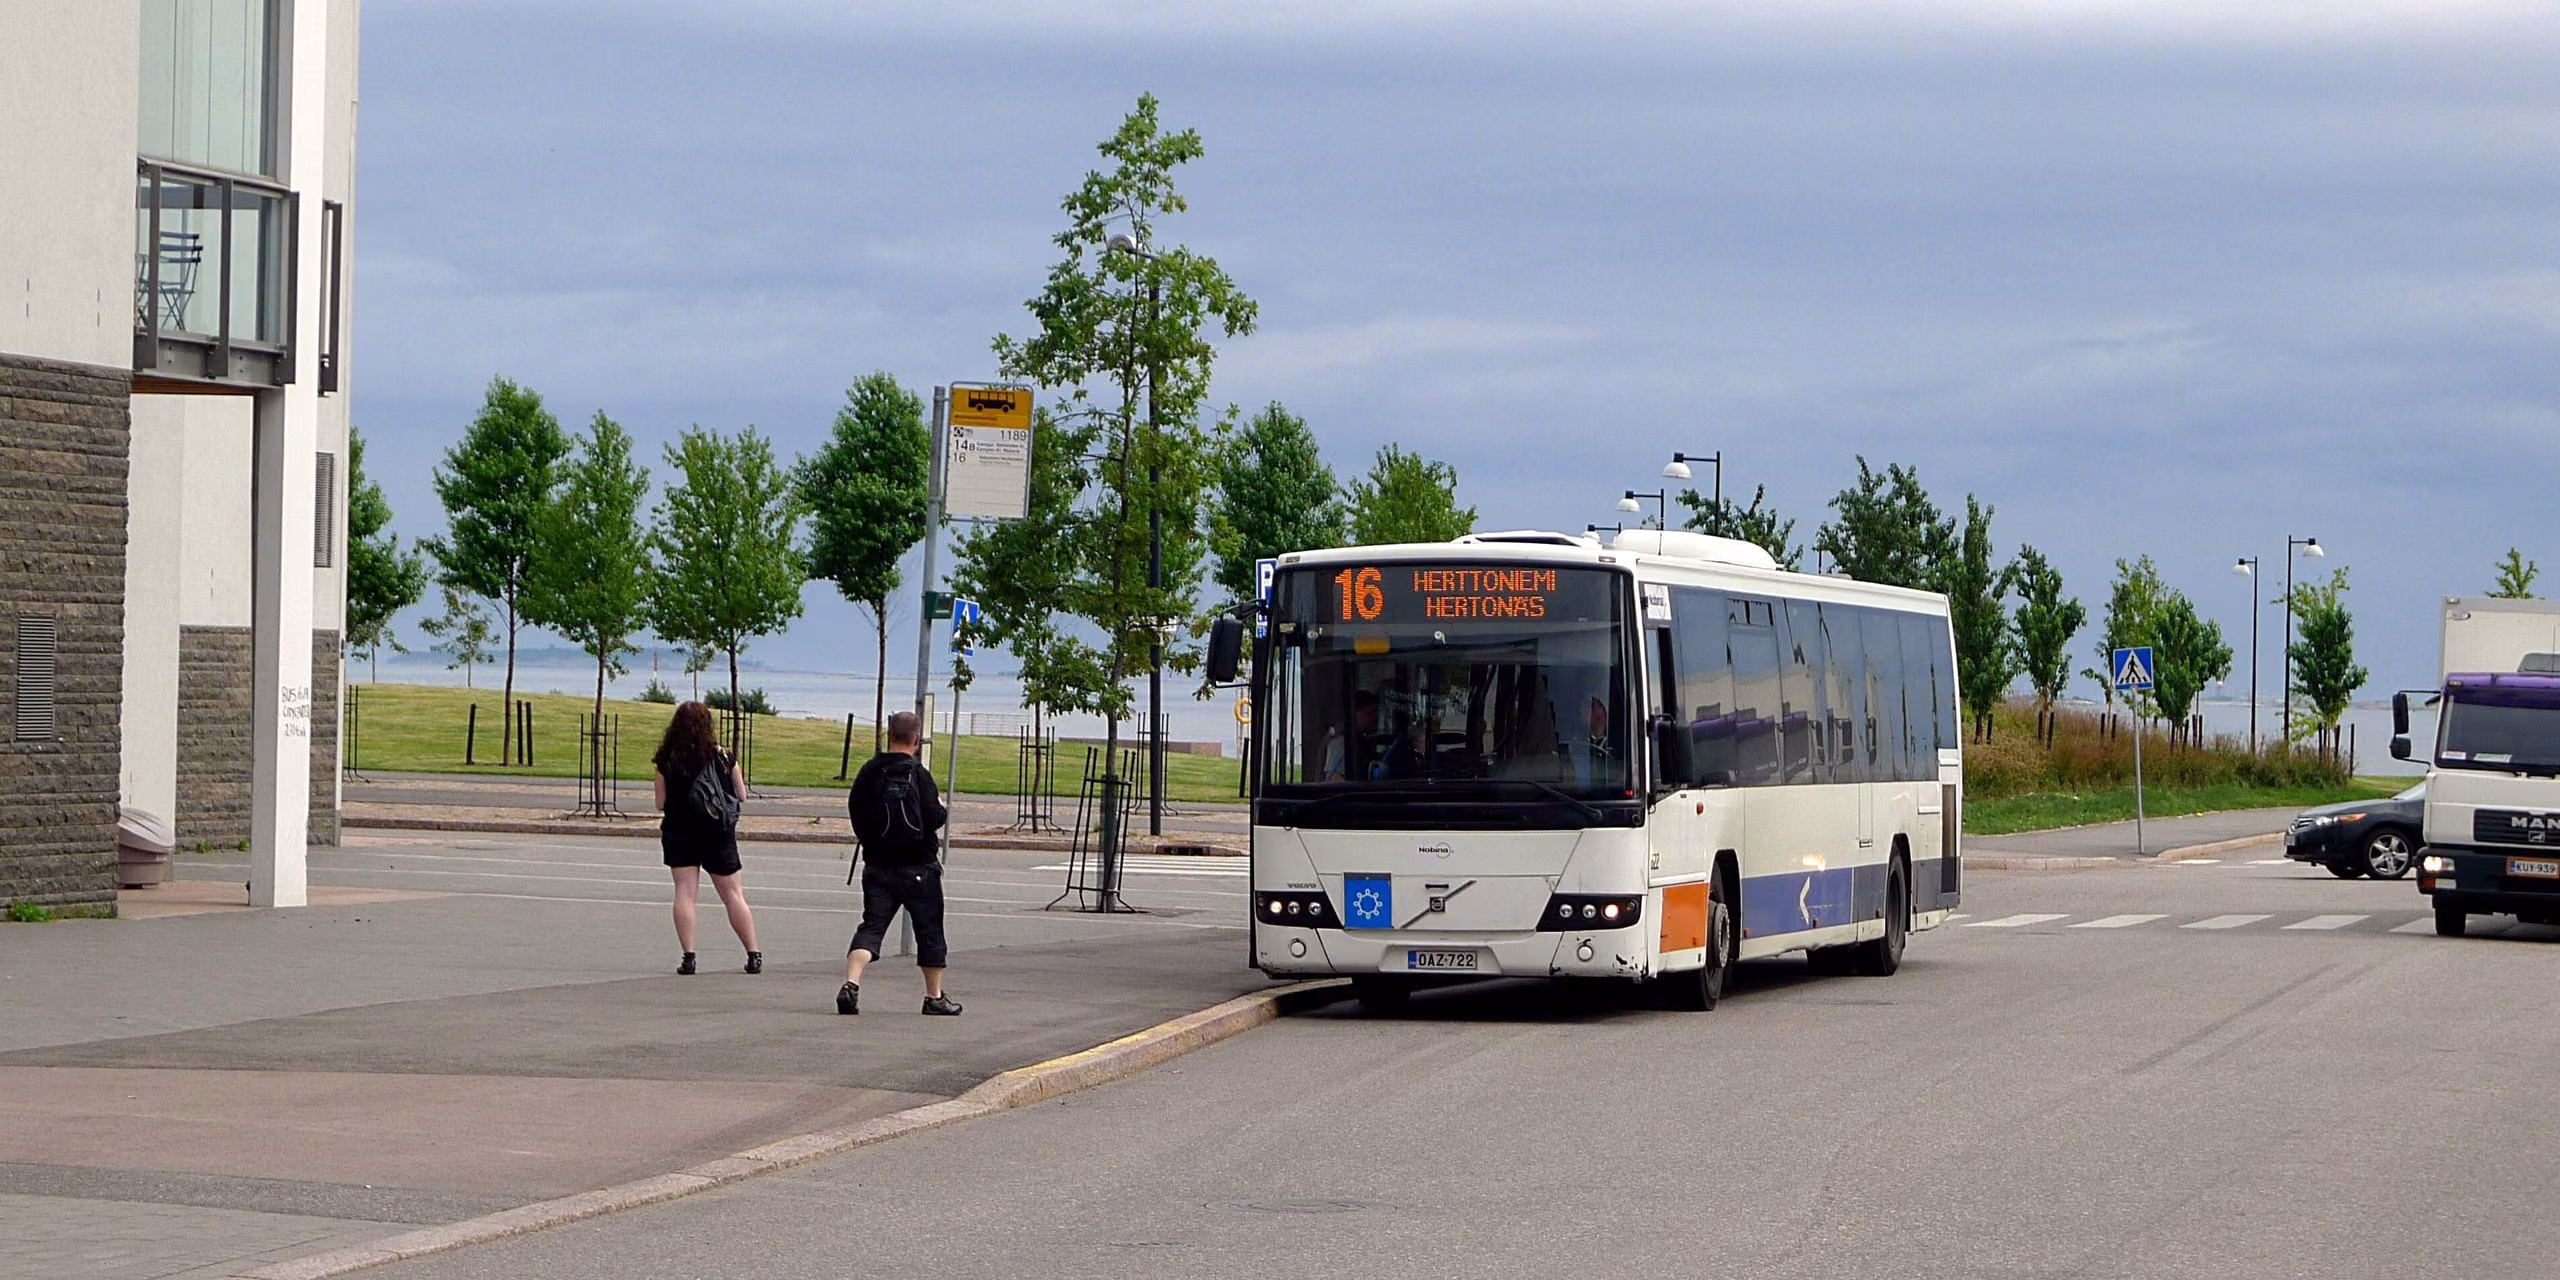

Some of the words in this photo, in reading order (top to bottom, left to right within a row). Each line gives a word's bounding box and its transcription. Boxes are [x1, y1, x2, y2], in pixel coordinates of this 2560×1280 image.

[1000, 429, 1027, 441] 1189
[953, 452, 966, 463] 16
[1260, 563, 1274, 600] P
[1334, 567, 1385, 621] 16
[1413, 569, 1557, 593] HERTTONIEMI
[1426, 595, 1546, 618] HERTONÄS
[2511, 816, 2560, 829] MAN
[1418, 953, 1474, 967] OAZ-722
